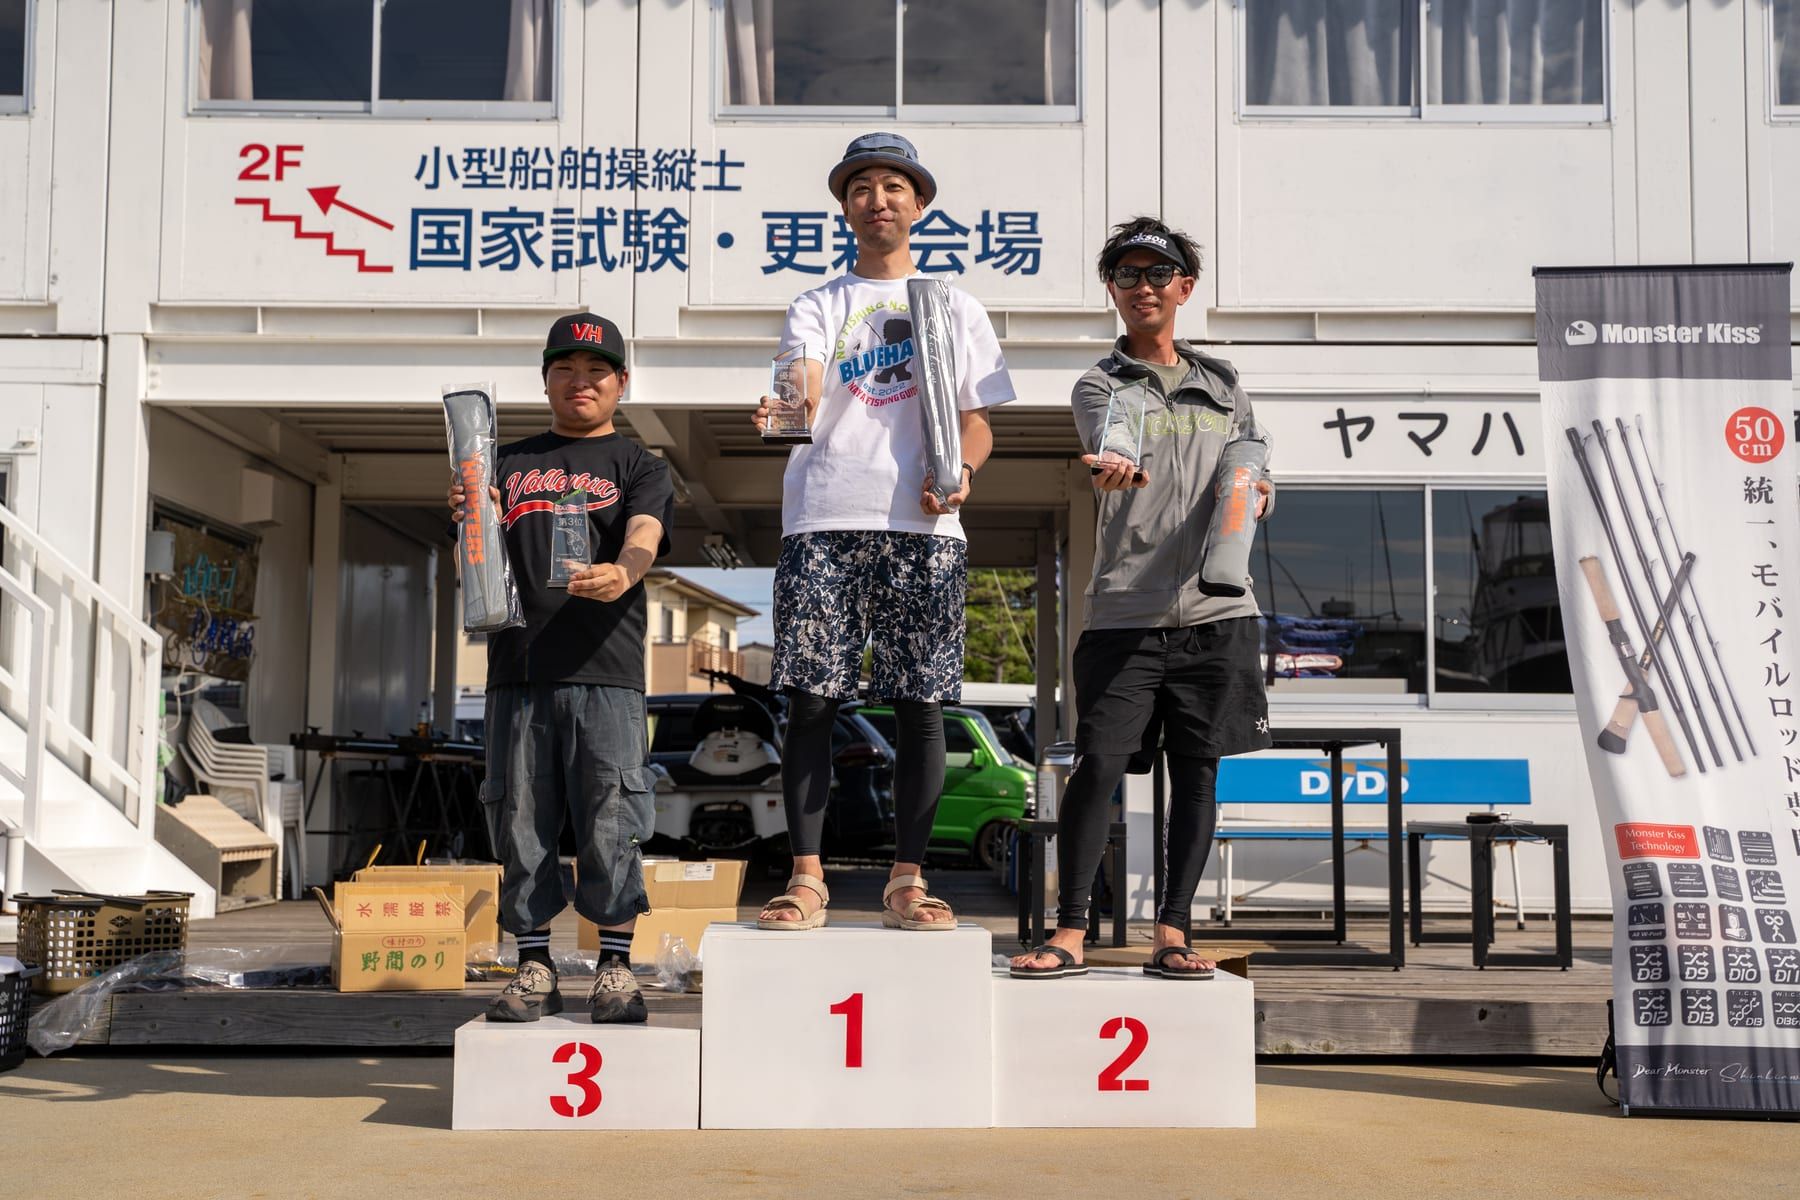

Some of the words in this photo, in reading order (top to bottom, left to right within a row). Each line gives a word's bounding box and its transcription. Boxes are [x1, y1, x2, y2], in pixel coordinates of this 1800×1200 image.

[238, 143, 304, 181] 2F
[414, 146, 745, 192] 小型船舶操縦士
[570, 323, 603, 344] VH
[836, 340, 846, 360] NO
[842, 301, 885, 337] FISHING
[1602, 323, 1702, 345] Monster
[1707, 323, 1761, 345] Kiss
[865, 395, 900, 407] FISHING
[1323, 408, 1525, 459] ヤマハ
[1734, 416, 1776, 442] 50
[1739, 443, 1773, 457] cm
[460, 460, 486, 566] HUNTERS
[1625, 829, 1665, 839] Monster
[1667, 830, 1686, 840] Kiss
[1630, 841, 1686, 853] Technology
[361, 950, 445, 971] 野間のり
[1637, 967, 1662, 981] D8
[1685, 967, 1709, 980] D9
[829, 992, 864, 1068] 1
[1097, 1016, 1149, 1091] 2
[549, 1042, 603, 1117] 3
[1632, 1063, 1664, 1079] Dear
[1664, 1062, 1713, 1077] Monster
